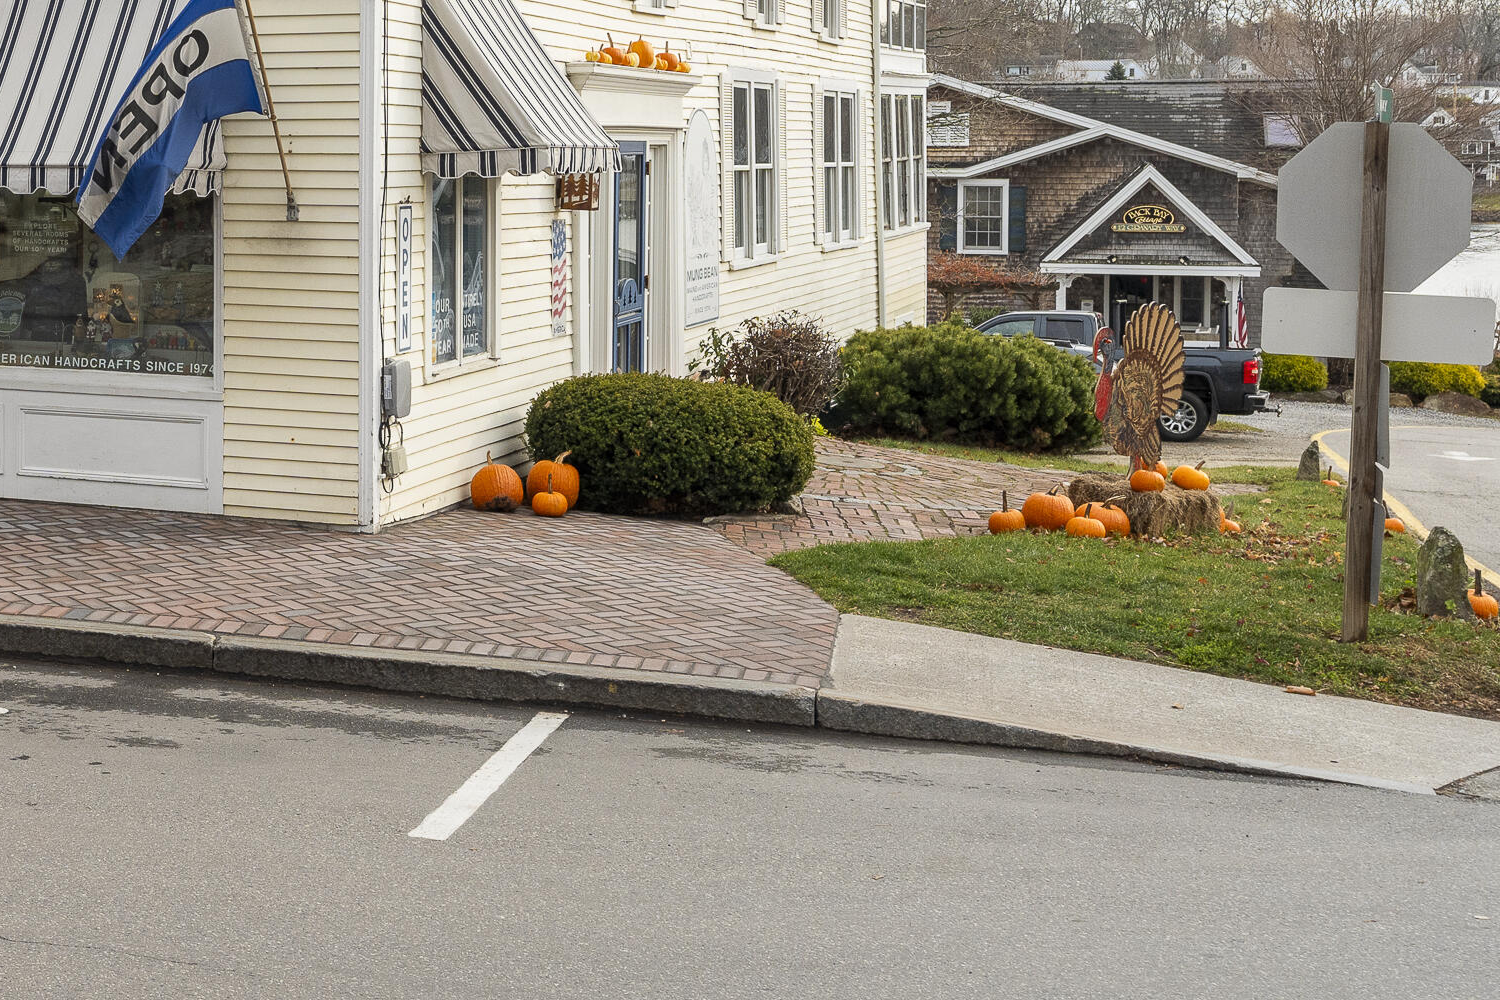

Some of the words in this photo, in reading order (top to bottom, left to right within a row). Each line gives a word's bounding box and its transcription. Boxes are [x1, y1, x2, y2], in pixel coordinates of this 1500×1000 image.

[1128, 208, 1151, 219] BACK
[1153, 208, 1169, 219] BAY
[12, 230, 43, 238] SEVERAL
[1164, 224, 1180, 232] WAY
[24, 238, 69, 246] HANDCRAFTS
[687, 269, 703, 281] MUNG
[704, 267, 718, 279] BEAN
[435, 298, 450, 313] OUR
[463, 313, 477, 328] USA
[436, 339, 452, 356] EAR
[54, 356, 141, 371] HANDCRAFTS
[145, 360, 184, 373] SINCE
[189, 363, 215, 375] 1974
